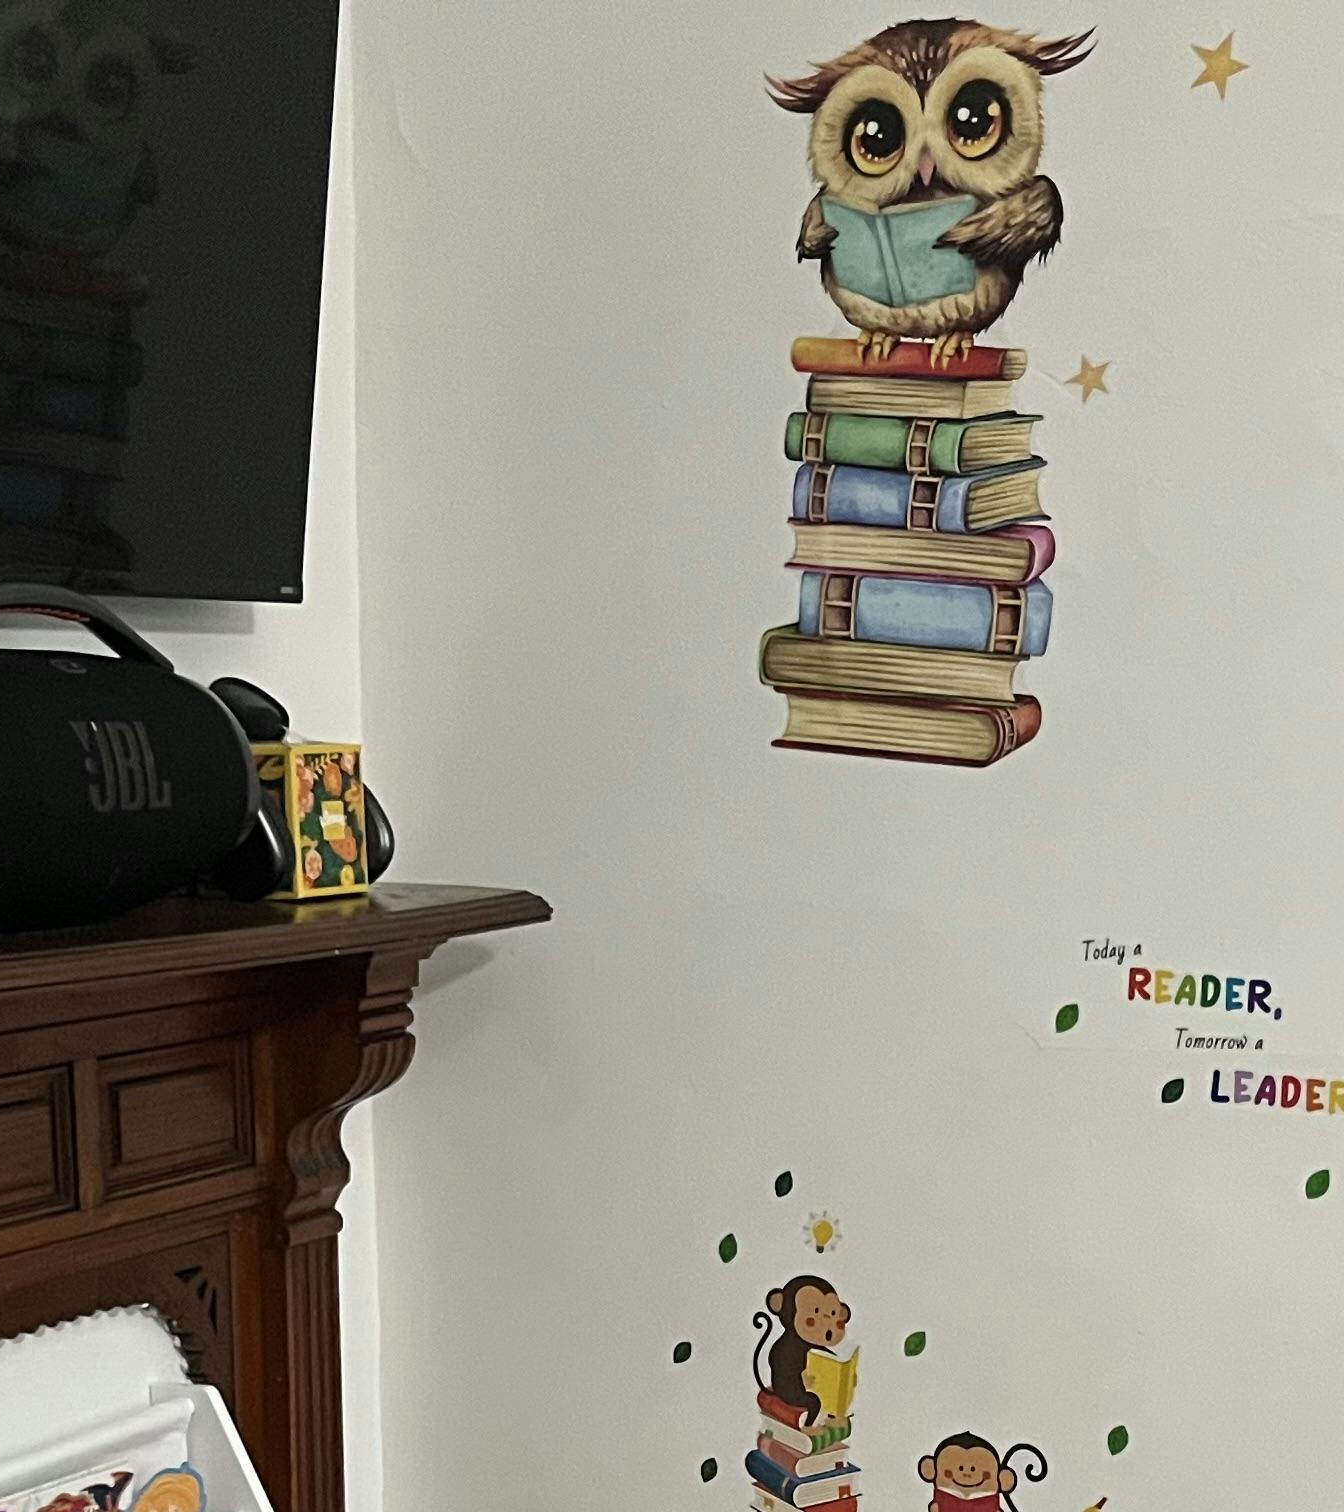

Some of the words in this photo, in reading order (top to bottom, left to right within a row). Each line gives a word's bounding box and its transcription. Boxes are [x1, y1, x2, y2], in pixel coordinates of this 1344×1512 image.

[89, 720, 172, 812] JBL
[1082, 938, 1126, 966] Today
[1132, 943, 1143, 956] a
[1127, 966, 1283, 1021] READER,
[1174, 1027, 1249, 1051] Tomorrow
[1254, 1037, 1264, 1051] a
